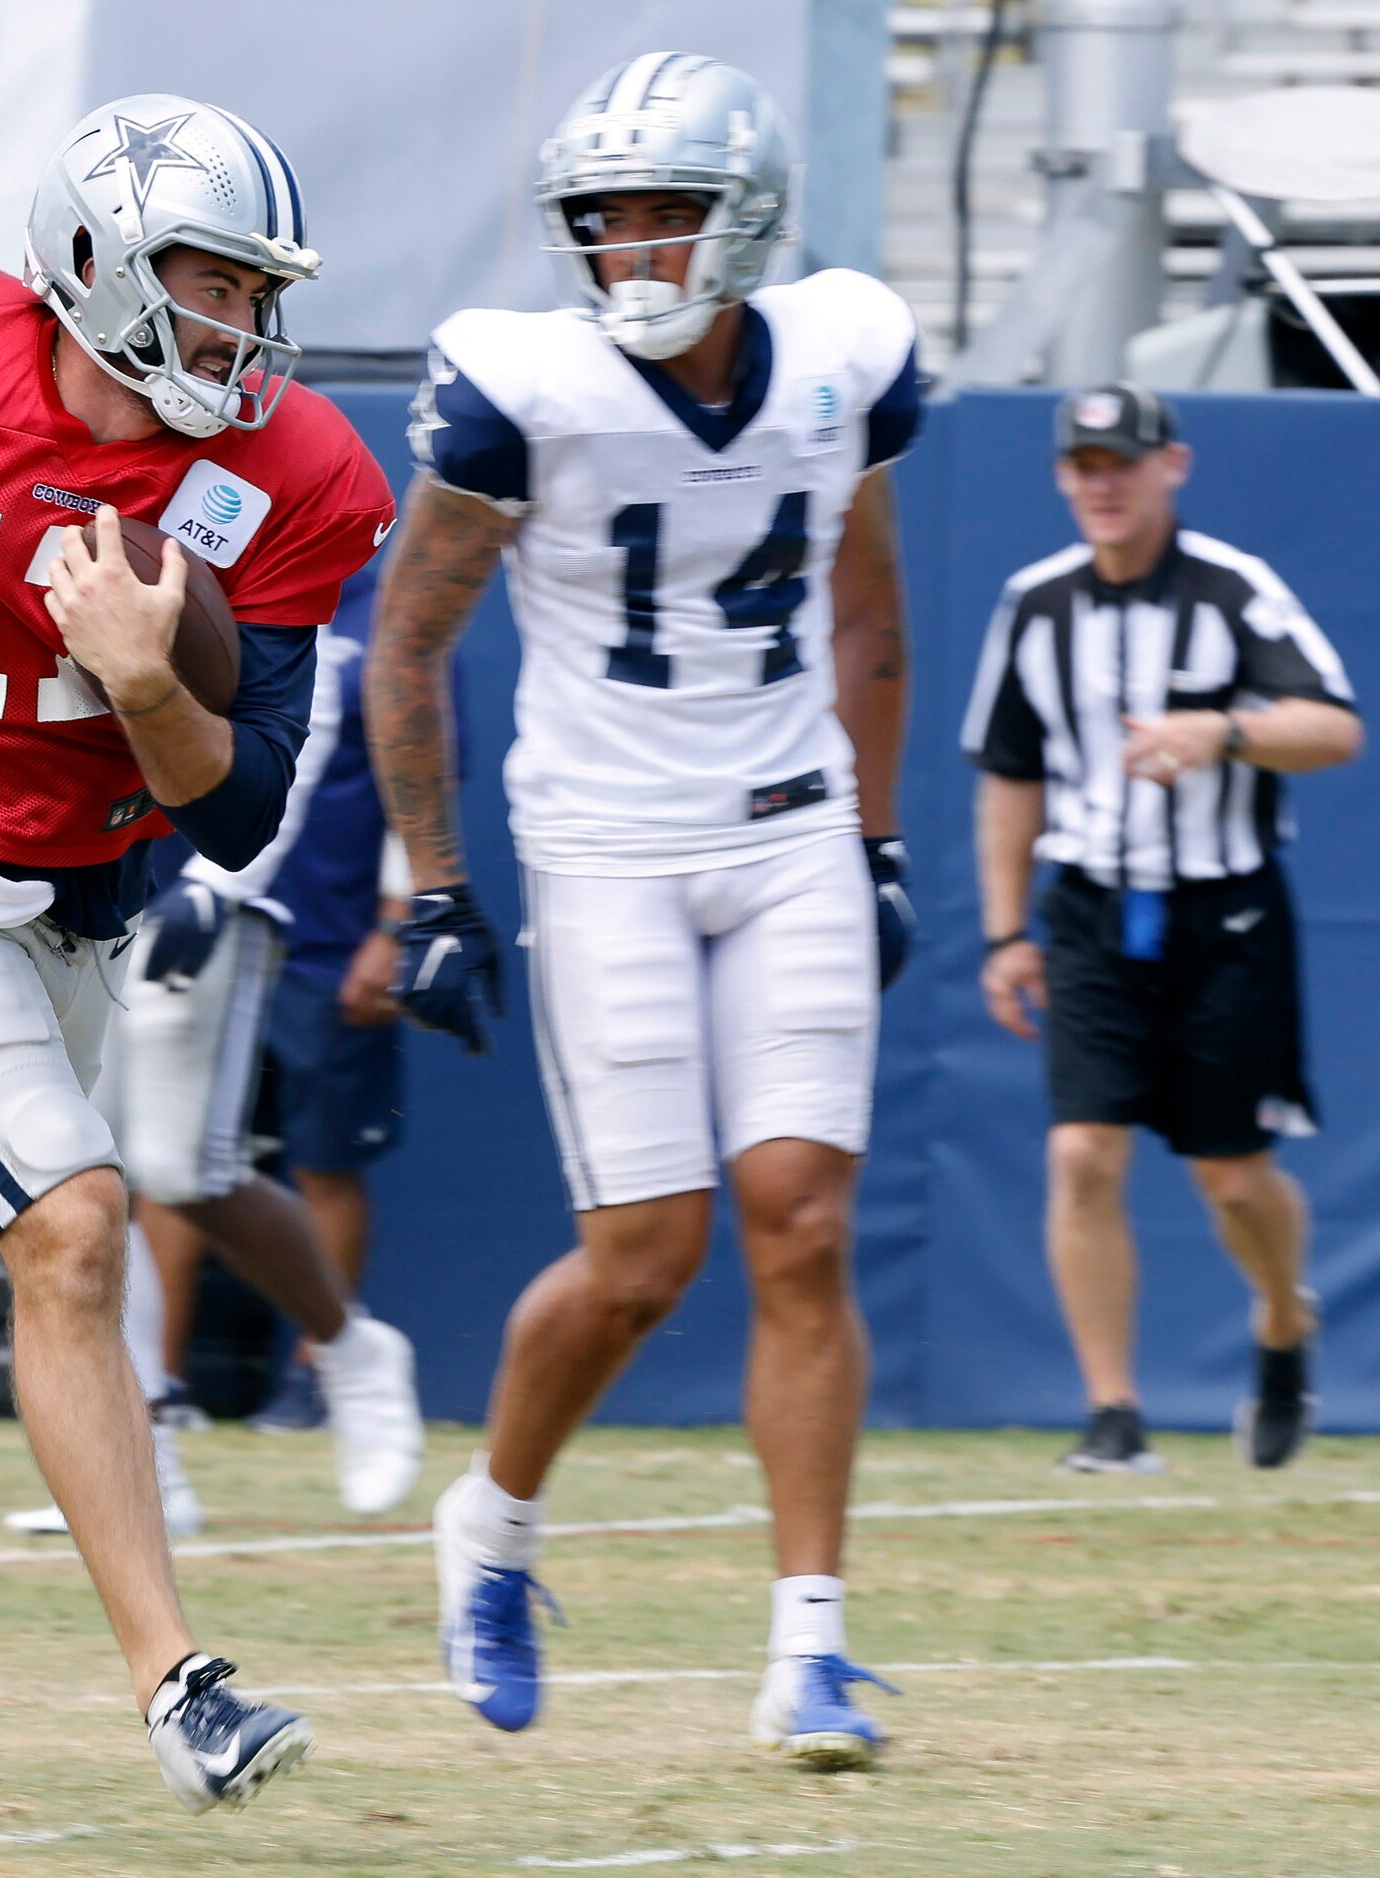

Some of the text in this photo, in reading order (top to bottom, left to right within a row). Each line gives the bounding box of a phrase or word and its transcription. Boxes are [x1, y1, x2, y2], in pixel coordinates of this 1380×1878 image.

[32, 483, 103, 516] COWBOY
[178, 518, 229, 552] AT&T
[605, 490, 811, 690] 14
